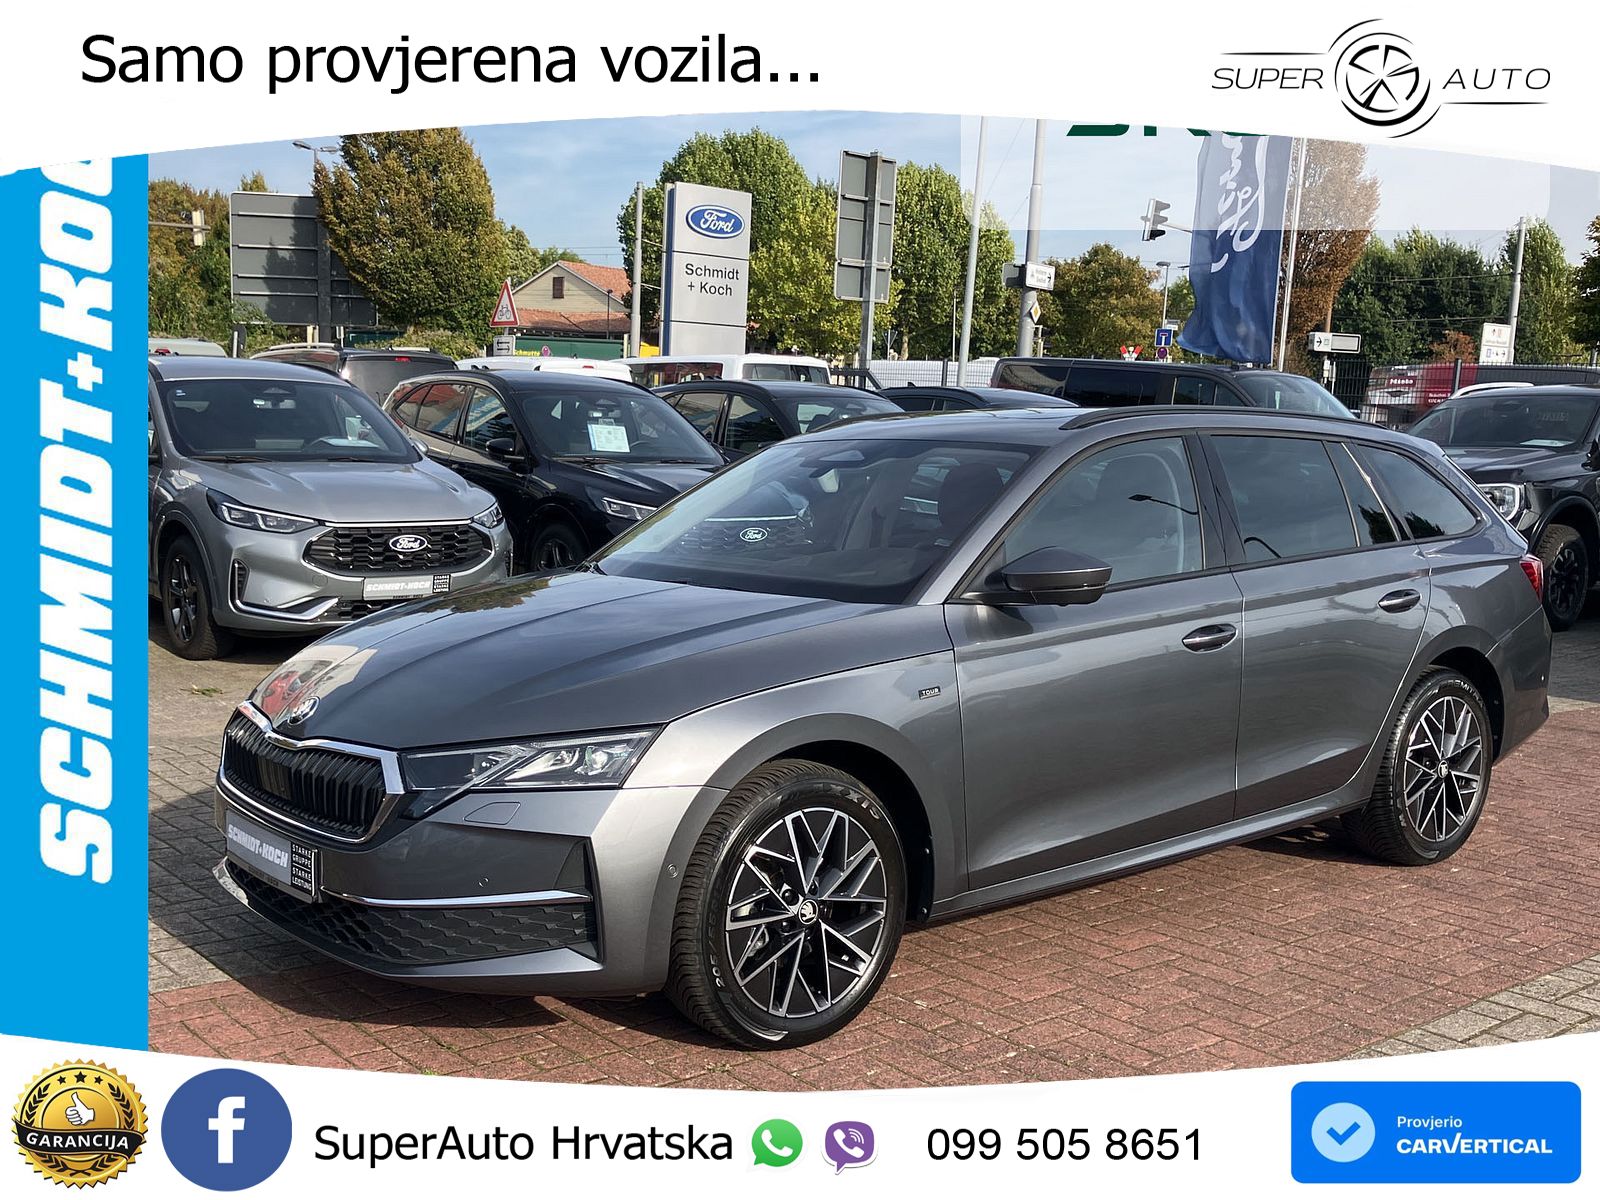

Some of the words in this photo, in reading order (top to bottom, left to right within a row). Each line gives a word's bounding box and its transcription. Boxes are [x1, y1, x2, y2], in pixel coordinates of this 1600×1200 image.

[700, 210, 735, 232] Ford
[685, 263, 739, 280] Schmidt
[700, 282, 732, 296] Koch
[396, 538, 420, 549] Ford
[921, 688, 939, 696] TOUR
[292, 844, 311, 858] STARKE
[292, 854, 311, 868] GRUPPE
[292, 867, 311, 882] STARKE
